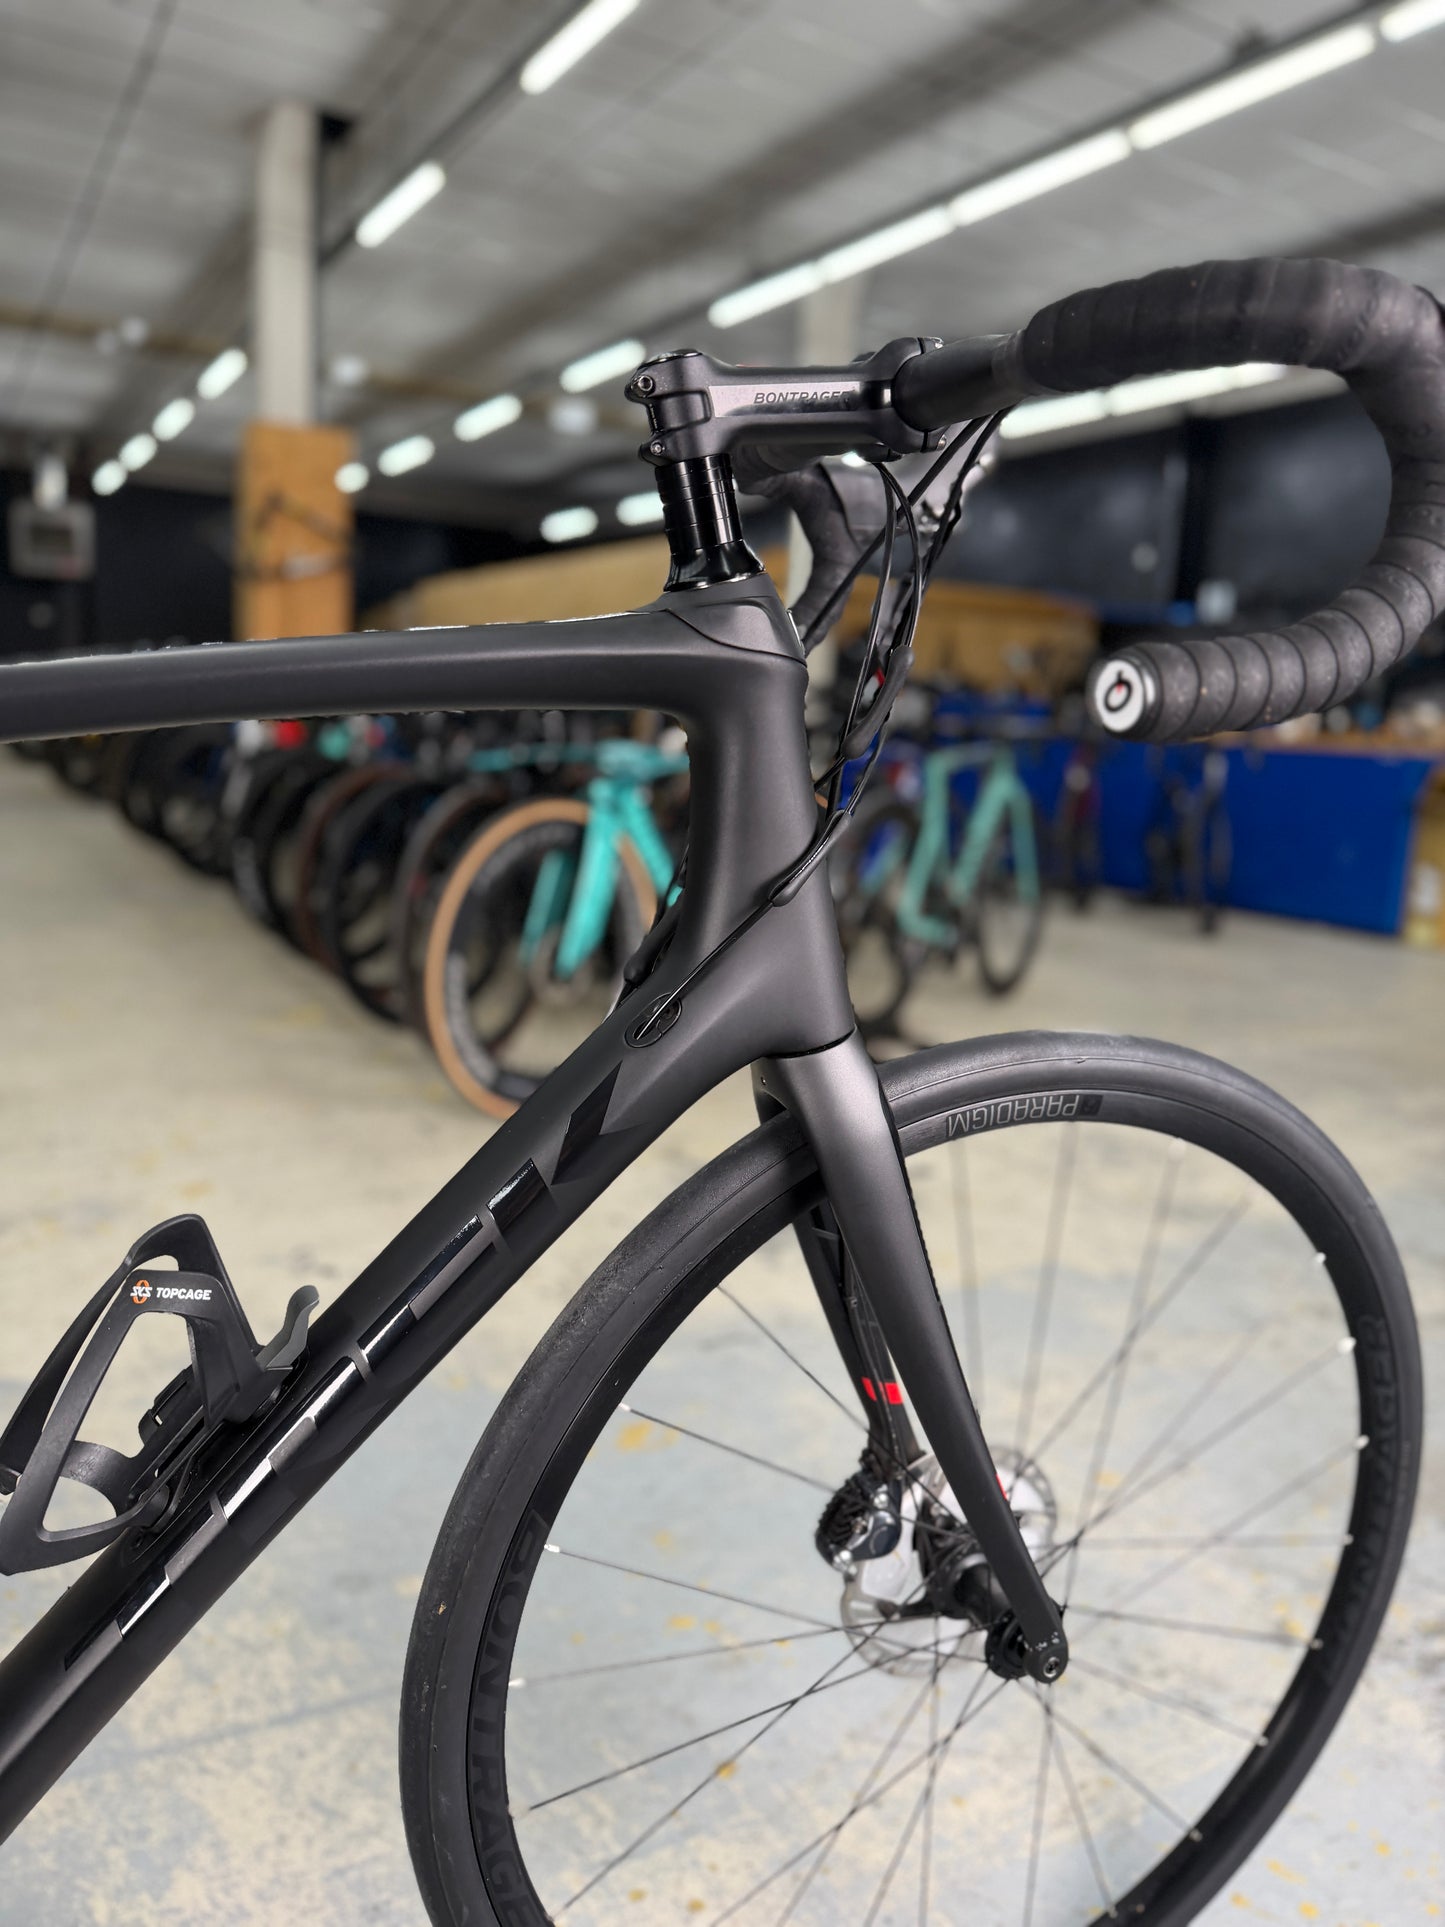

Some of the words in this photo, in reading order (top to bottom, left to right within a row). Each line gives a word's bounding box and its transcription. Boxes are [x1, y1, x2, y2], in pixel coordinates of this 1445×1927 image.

[948, 1095, 1080, 1137] PARADIGM
[130, 1286, 153, 1298] SKS
[156, 1287, 213, 1300] TOPCAGE
